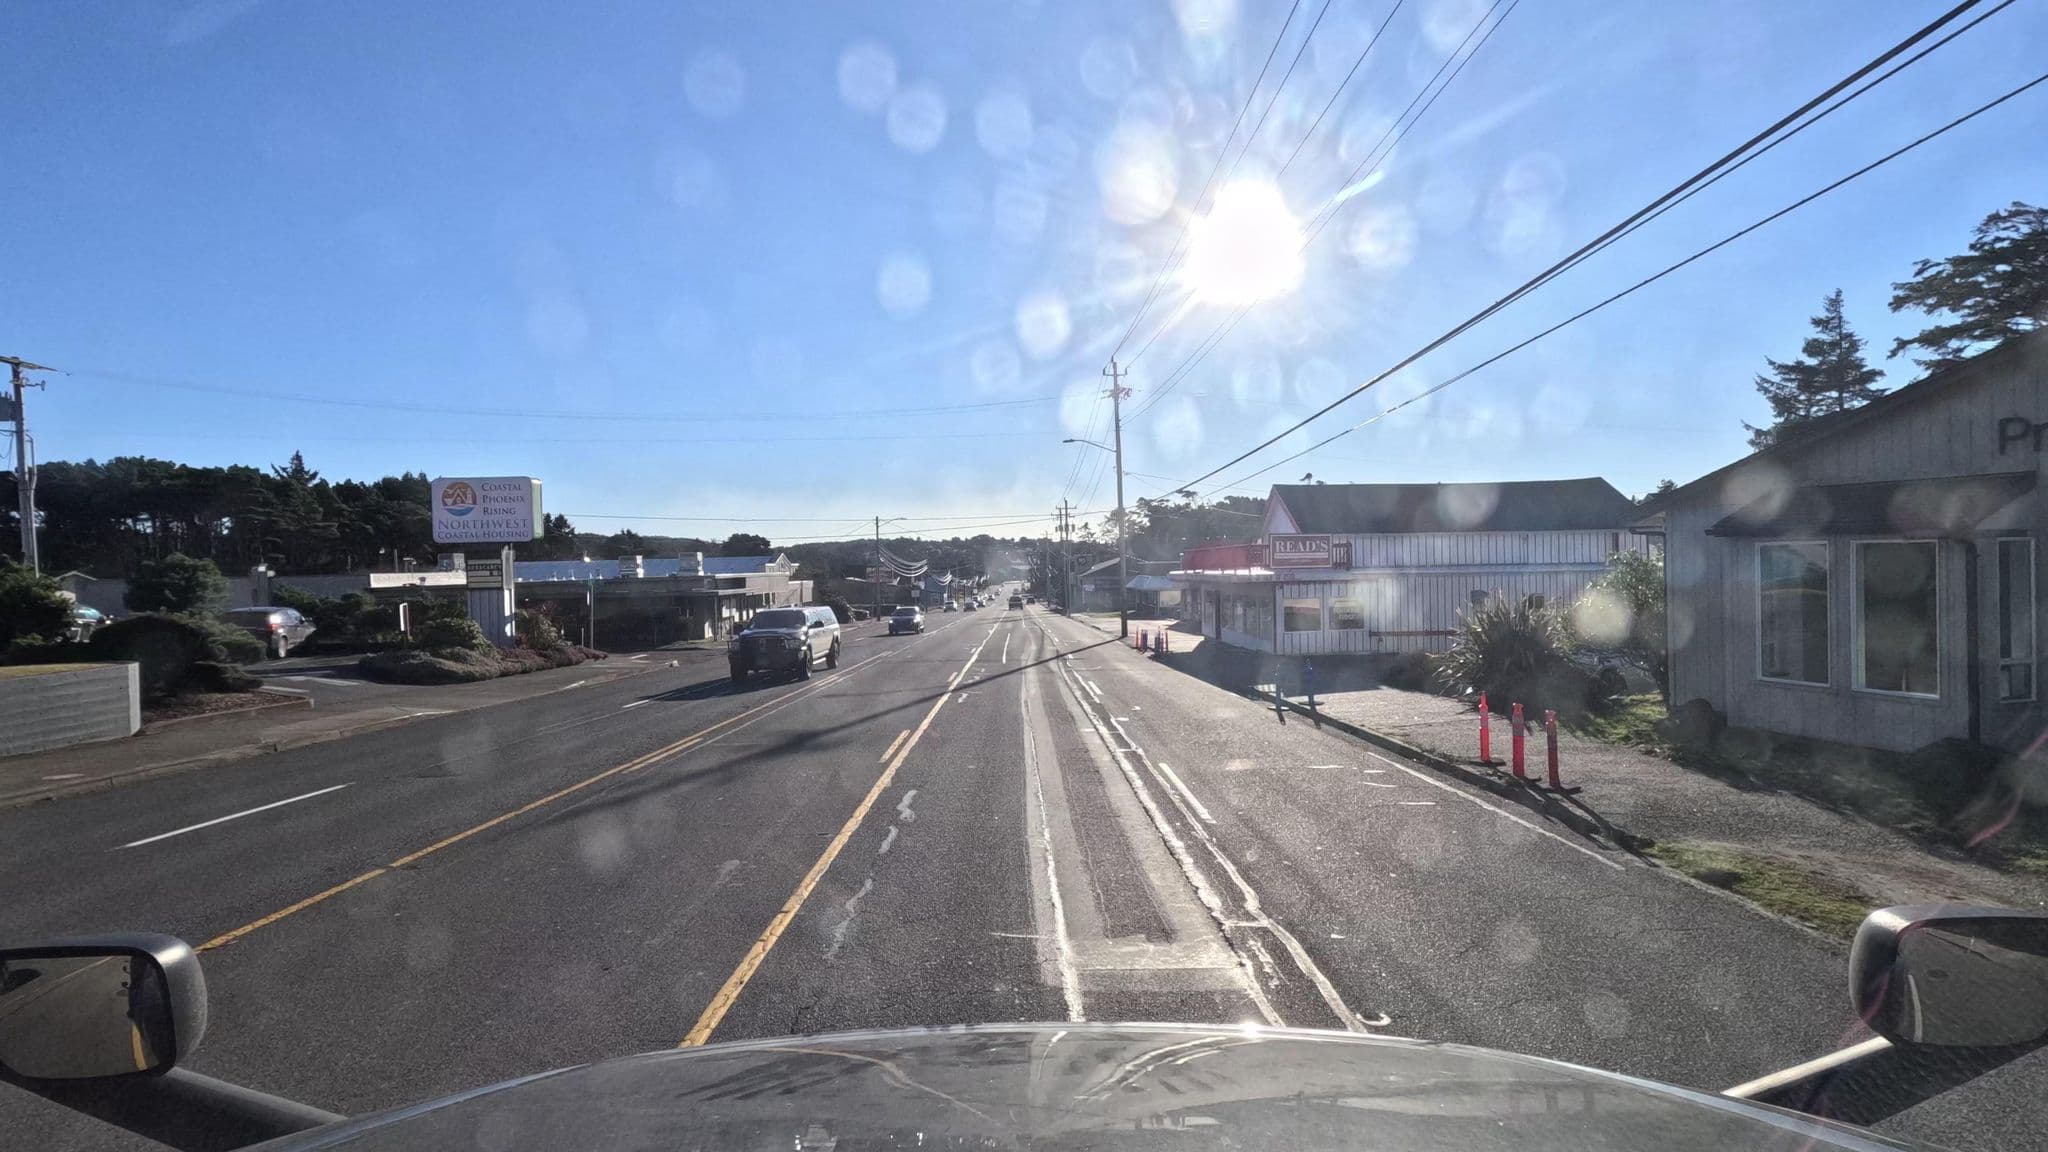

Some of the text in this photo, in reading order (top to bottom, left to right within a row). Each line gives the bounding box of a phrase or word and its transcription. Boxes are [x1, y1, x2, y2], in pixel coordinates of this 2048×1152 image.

[481, 482, 523, 492] COASTAL
[482, 495, 525, 504] PHOENIX
[483, 506, 517, 516] RISING
[438, 519, 529, 530] NORTHWEST
[437, 531, 529, 540] COASTAL HOUSING
[1274, 539, 1329, 553] READ'S
